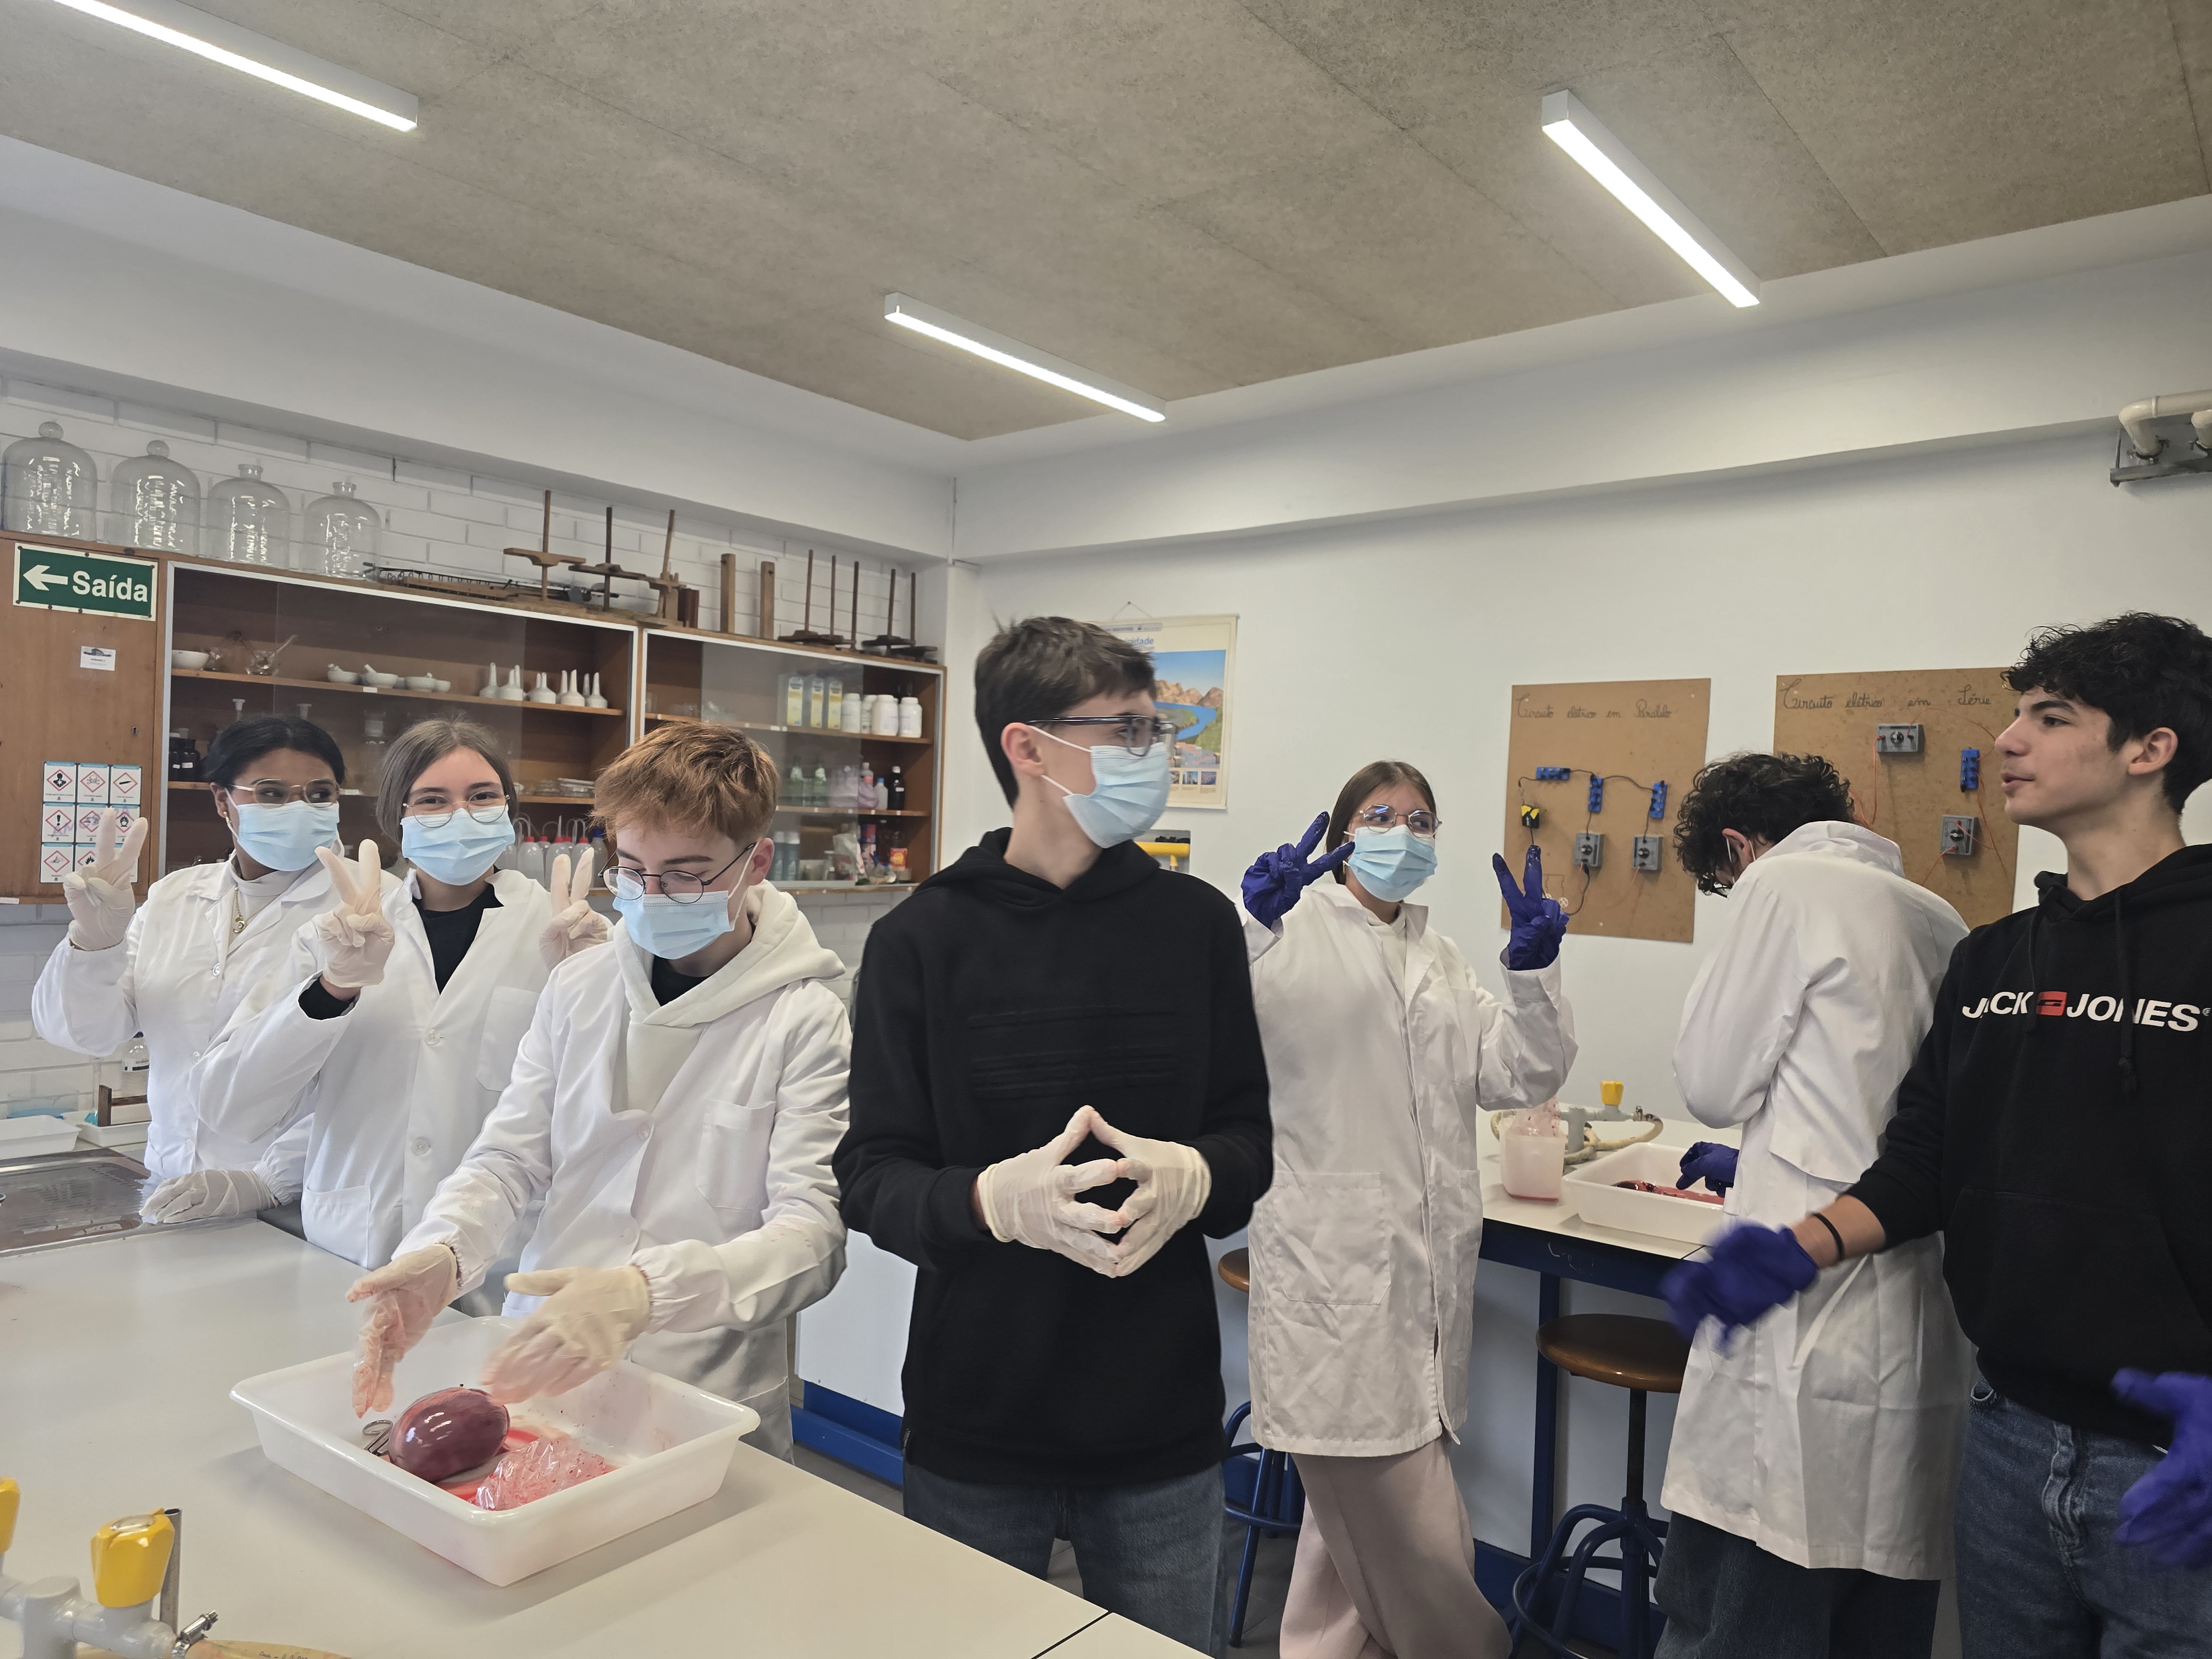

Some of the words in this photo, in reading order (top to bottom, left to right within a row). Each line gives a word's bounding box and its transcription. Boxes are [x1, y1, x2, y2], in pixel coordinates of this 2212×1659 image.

[72, 570, 148, 602] Saída
[1515, 692, 1554, 718] Circuito
[1779, 678, 1834, 709] Circuito
[1907, 698, 1931, 706] em
[2067, 994, 2200, 1032] JONES
